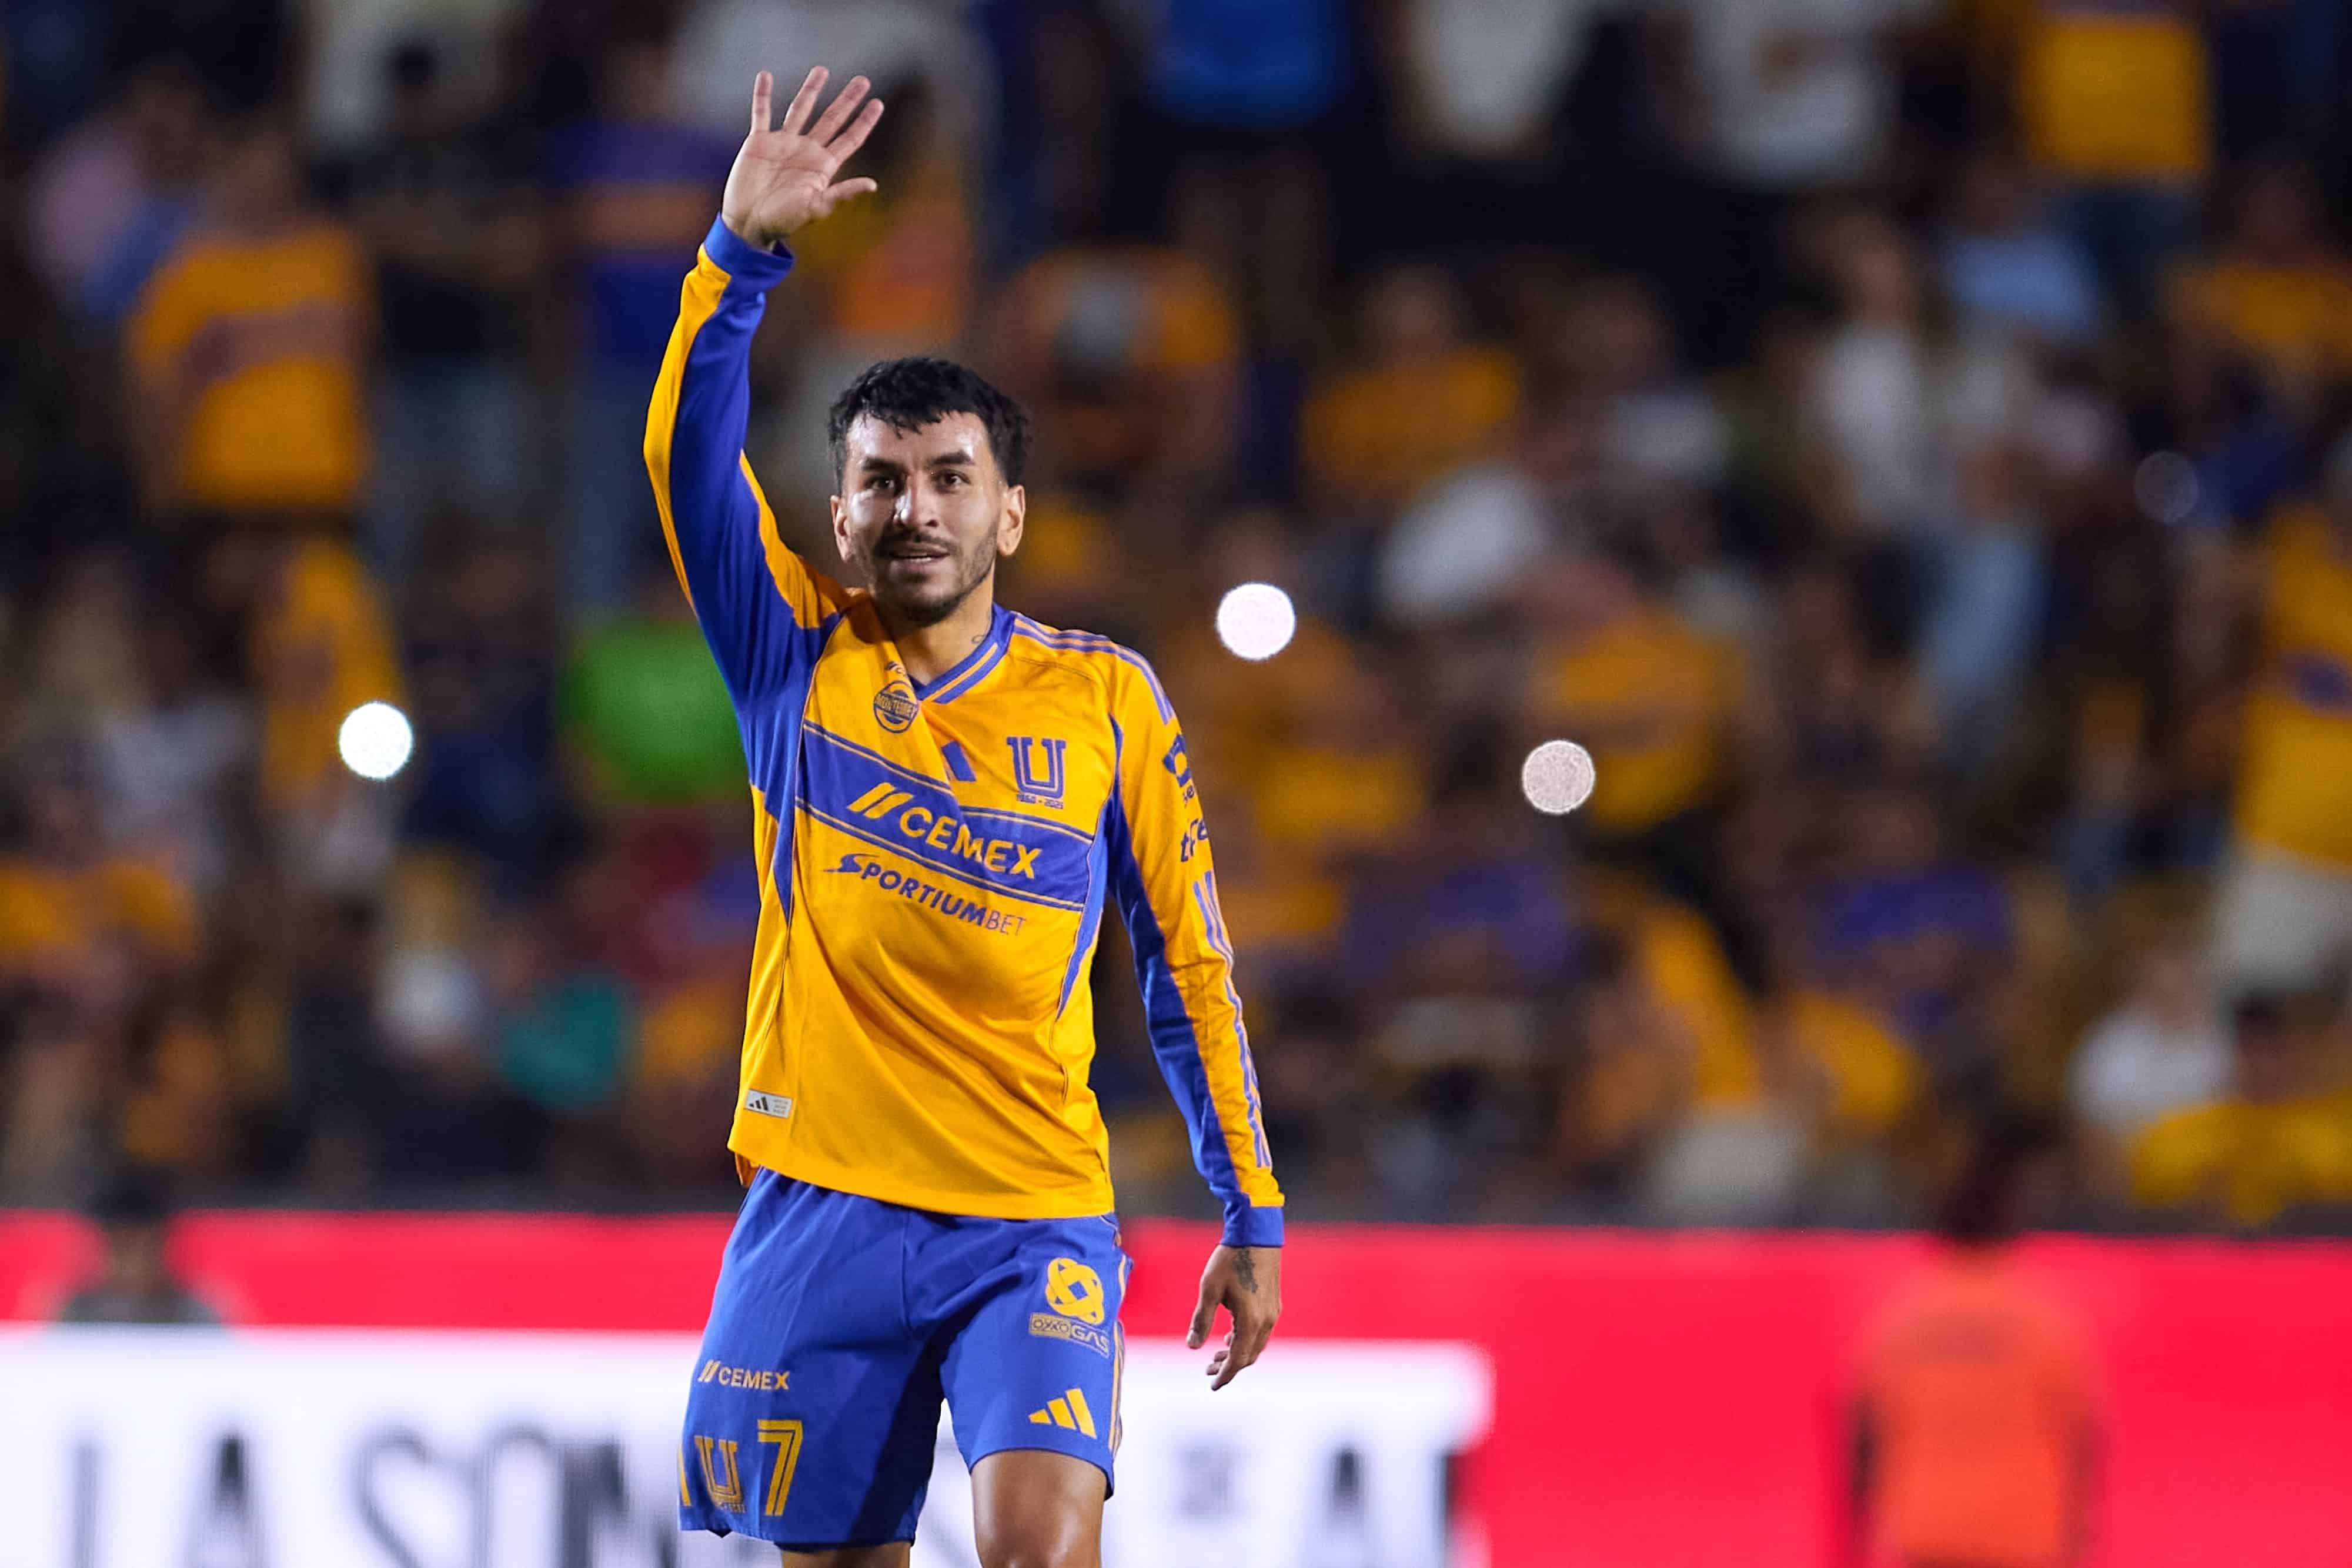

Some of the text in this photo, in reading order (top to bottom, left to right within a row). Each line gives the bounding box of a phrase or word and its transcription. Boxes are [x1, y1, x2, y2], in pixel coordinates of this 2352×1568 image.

[1006, 736, 1067, 799] U
[900, 806, 1043, 880] CEMEX
[718, 1366, 790, 1390] CEMEX
[694, 1435, 743, 1504] U
[757, 1419, 803, 1516] 7
